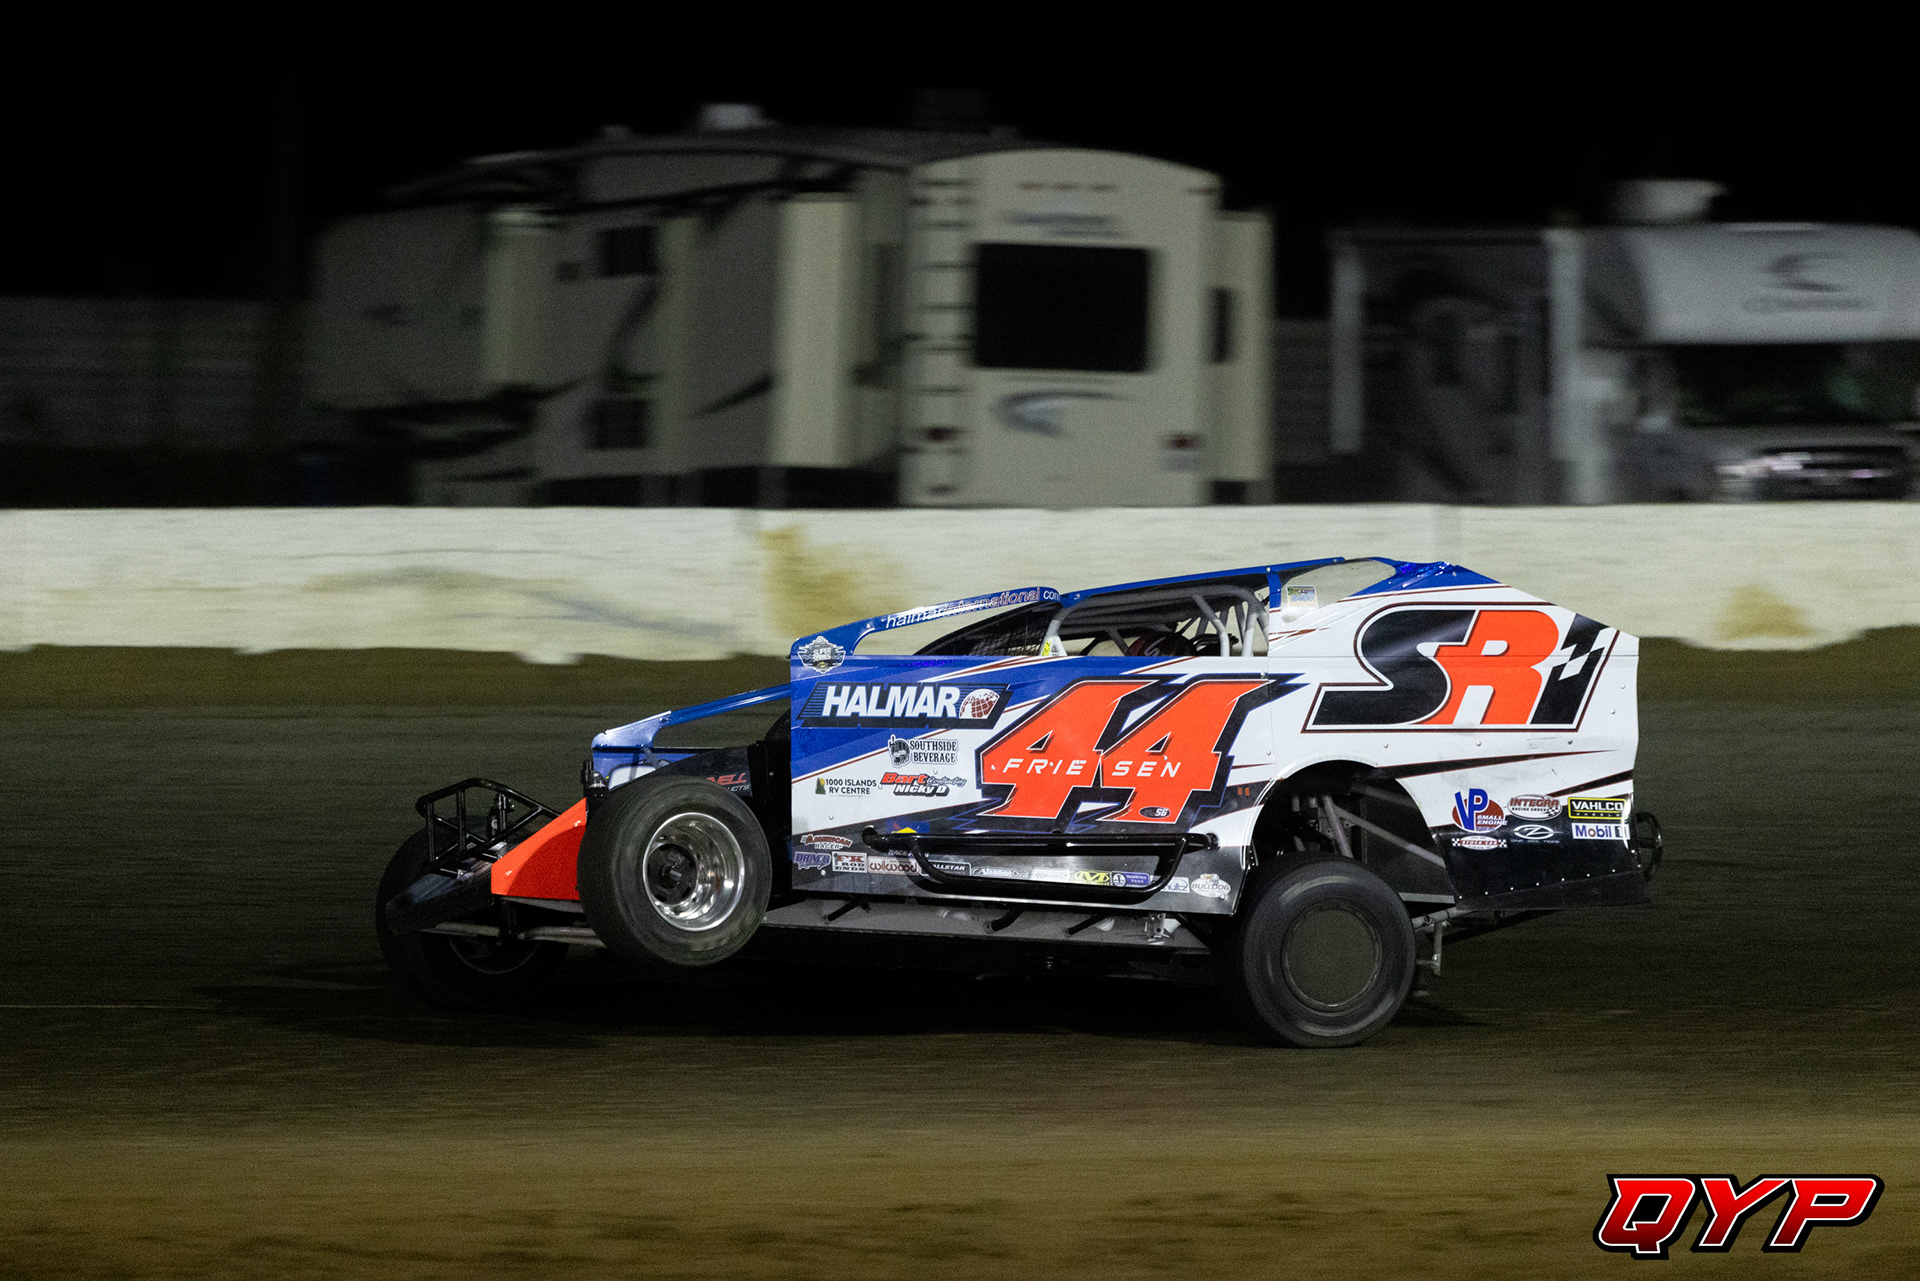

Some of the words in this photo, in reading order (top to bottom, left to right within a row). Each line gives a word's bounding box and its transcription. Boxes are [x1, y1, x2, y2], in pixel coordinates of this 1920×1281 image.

[822, 686, 960, 718] HALMAR
[909, 740, 957, 752] SOUTHSIDE
[978, 678, 1278, 823] 44
[913, 752, 956, 763] BEVERAGE
[825, 778, 843, 787] 1000
[844, 778, 877, 788] ISLANDS
[879, 772, 929, 786] Bart
[828, 786, 839, 795] RV
[841, 786, 871, 796] CENTRE
[1509, 798, 1559, 808] INTEGRA
[1572, 801, 1623, 811] VAHLCO
[1455, 788, 1489, 832] VP
[1575, 825, 1612, 838] Mobil
[871, 860, 918, 873] wilwood
[1191, 883, 1230, 891] BULLDOG
